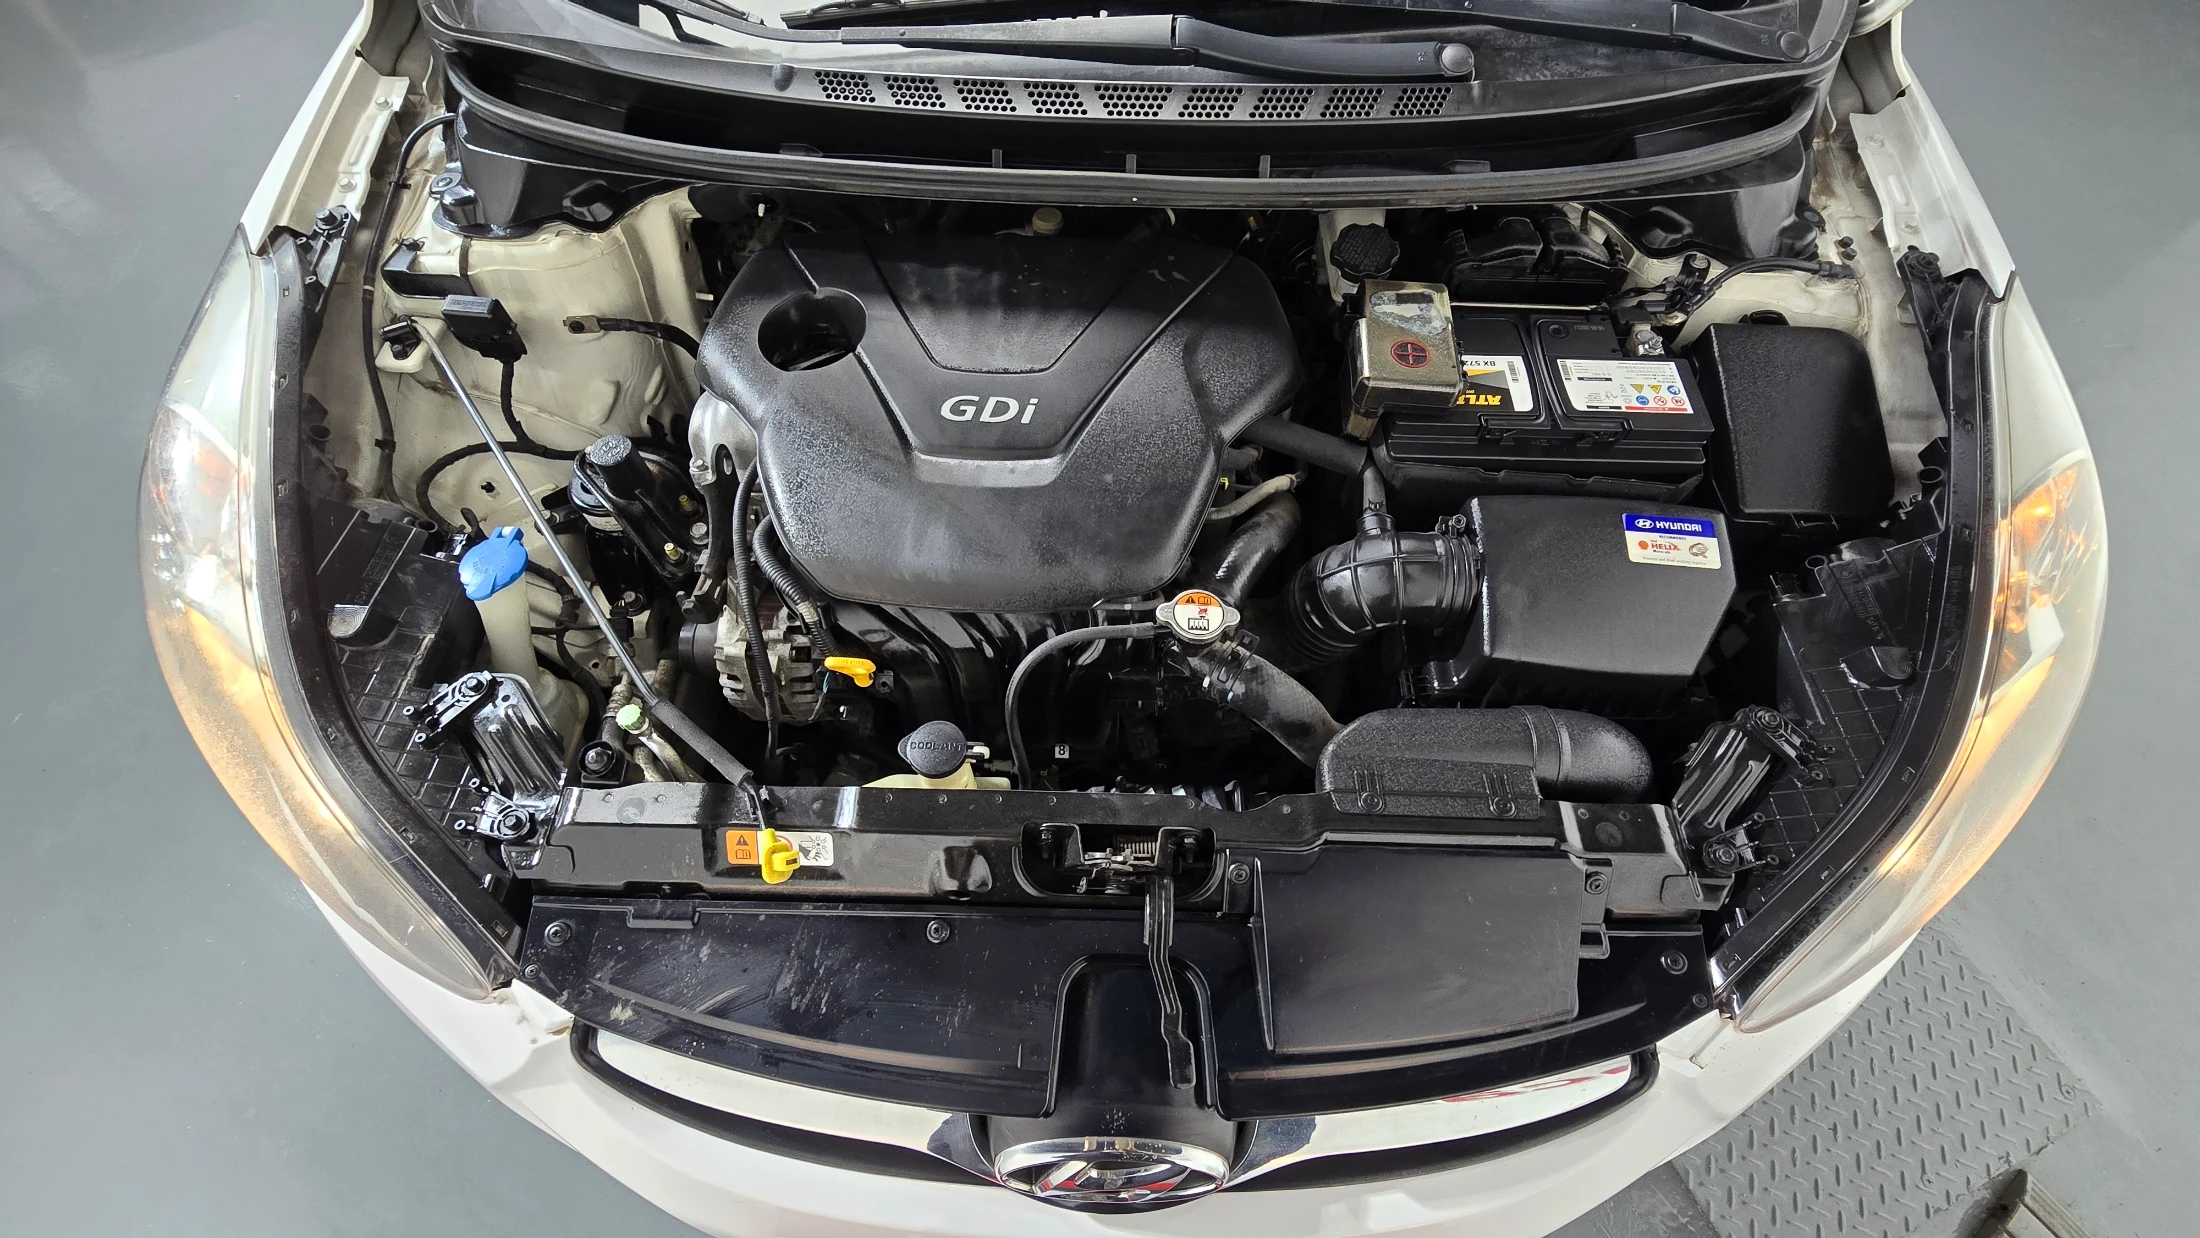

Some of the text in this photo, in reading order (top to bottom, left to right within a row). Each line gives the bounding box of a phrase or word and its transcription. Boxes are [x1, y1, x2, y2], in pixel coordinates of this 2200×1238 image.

[940, 395, 1039, 424] GDi
[1656, 521, 1702, 532] HYUNDAI
[1651, 542, 1680, 551] HELIX
[909, 741, 963, 751] COOLANT
[1058, 744, 1066, 756] 8
